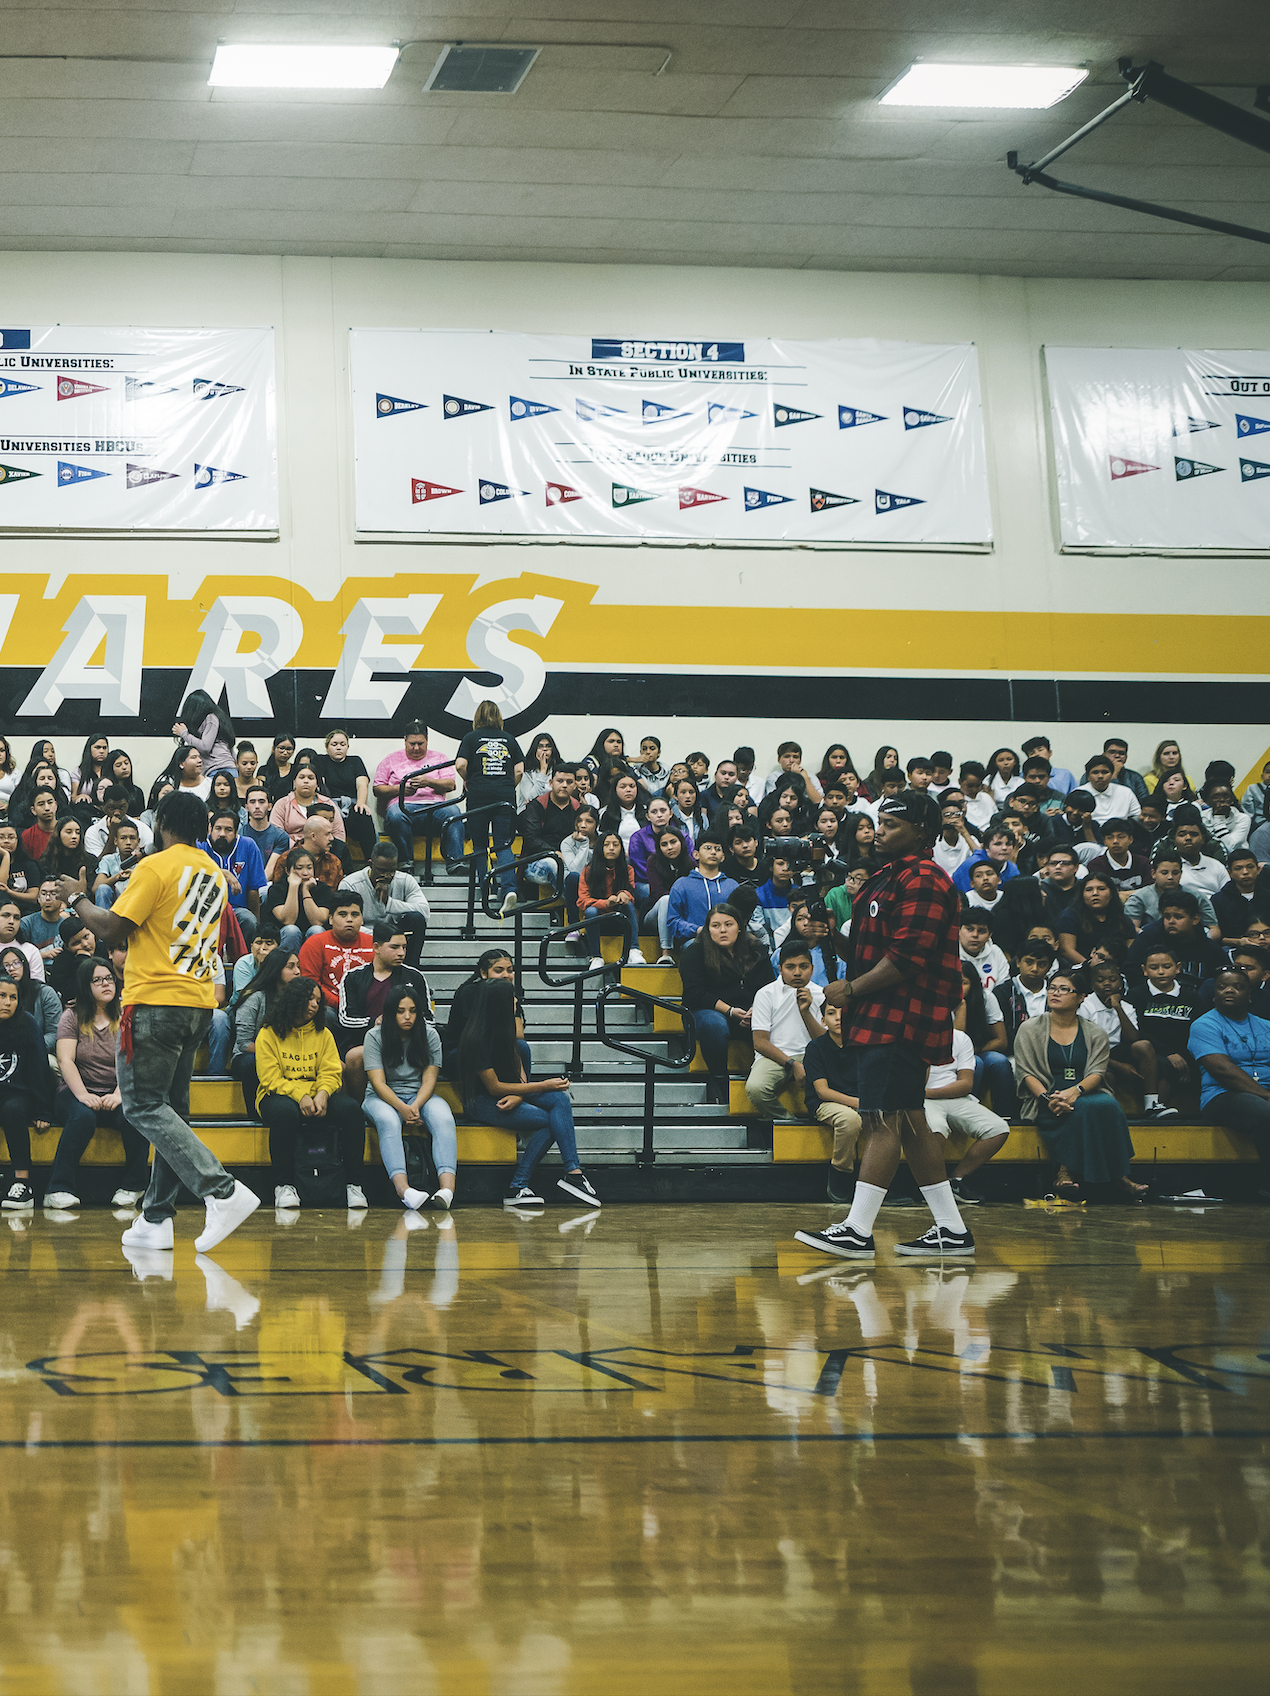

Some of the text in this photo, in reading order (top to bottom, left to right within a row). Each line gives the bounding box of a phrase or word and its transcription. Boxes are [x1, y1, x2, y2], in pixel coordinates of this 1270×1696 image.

[621, 341, 719, 360] SECTION 4
[569, 365, 583, 376] IN
[587, 366, 626, 377] STATE
[1230, 380, 1258, 392] OUT
[0, 439, 91, 452] UNIVERSITIES
